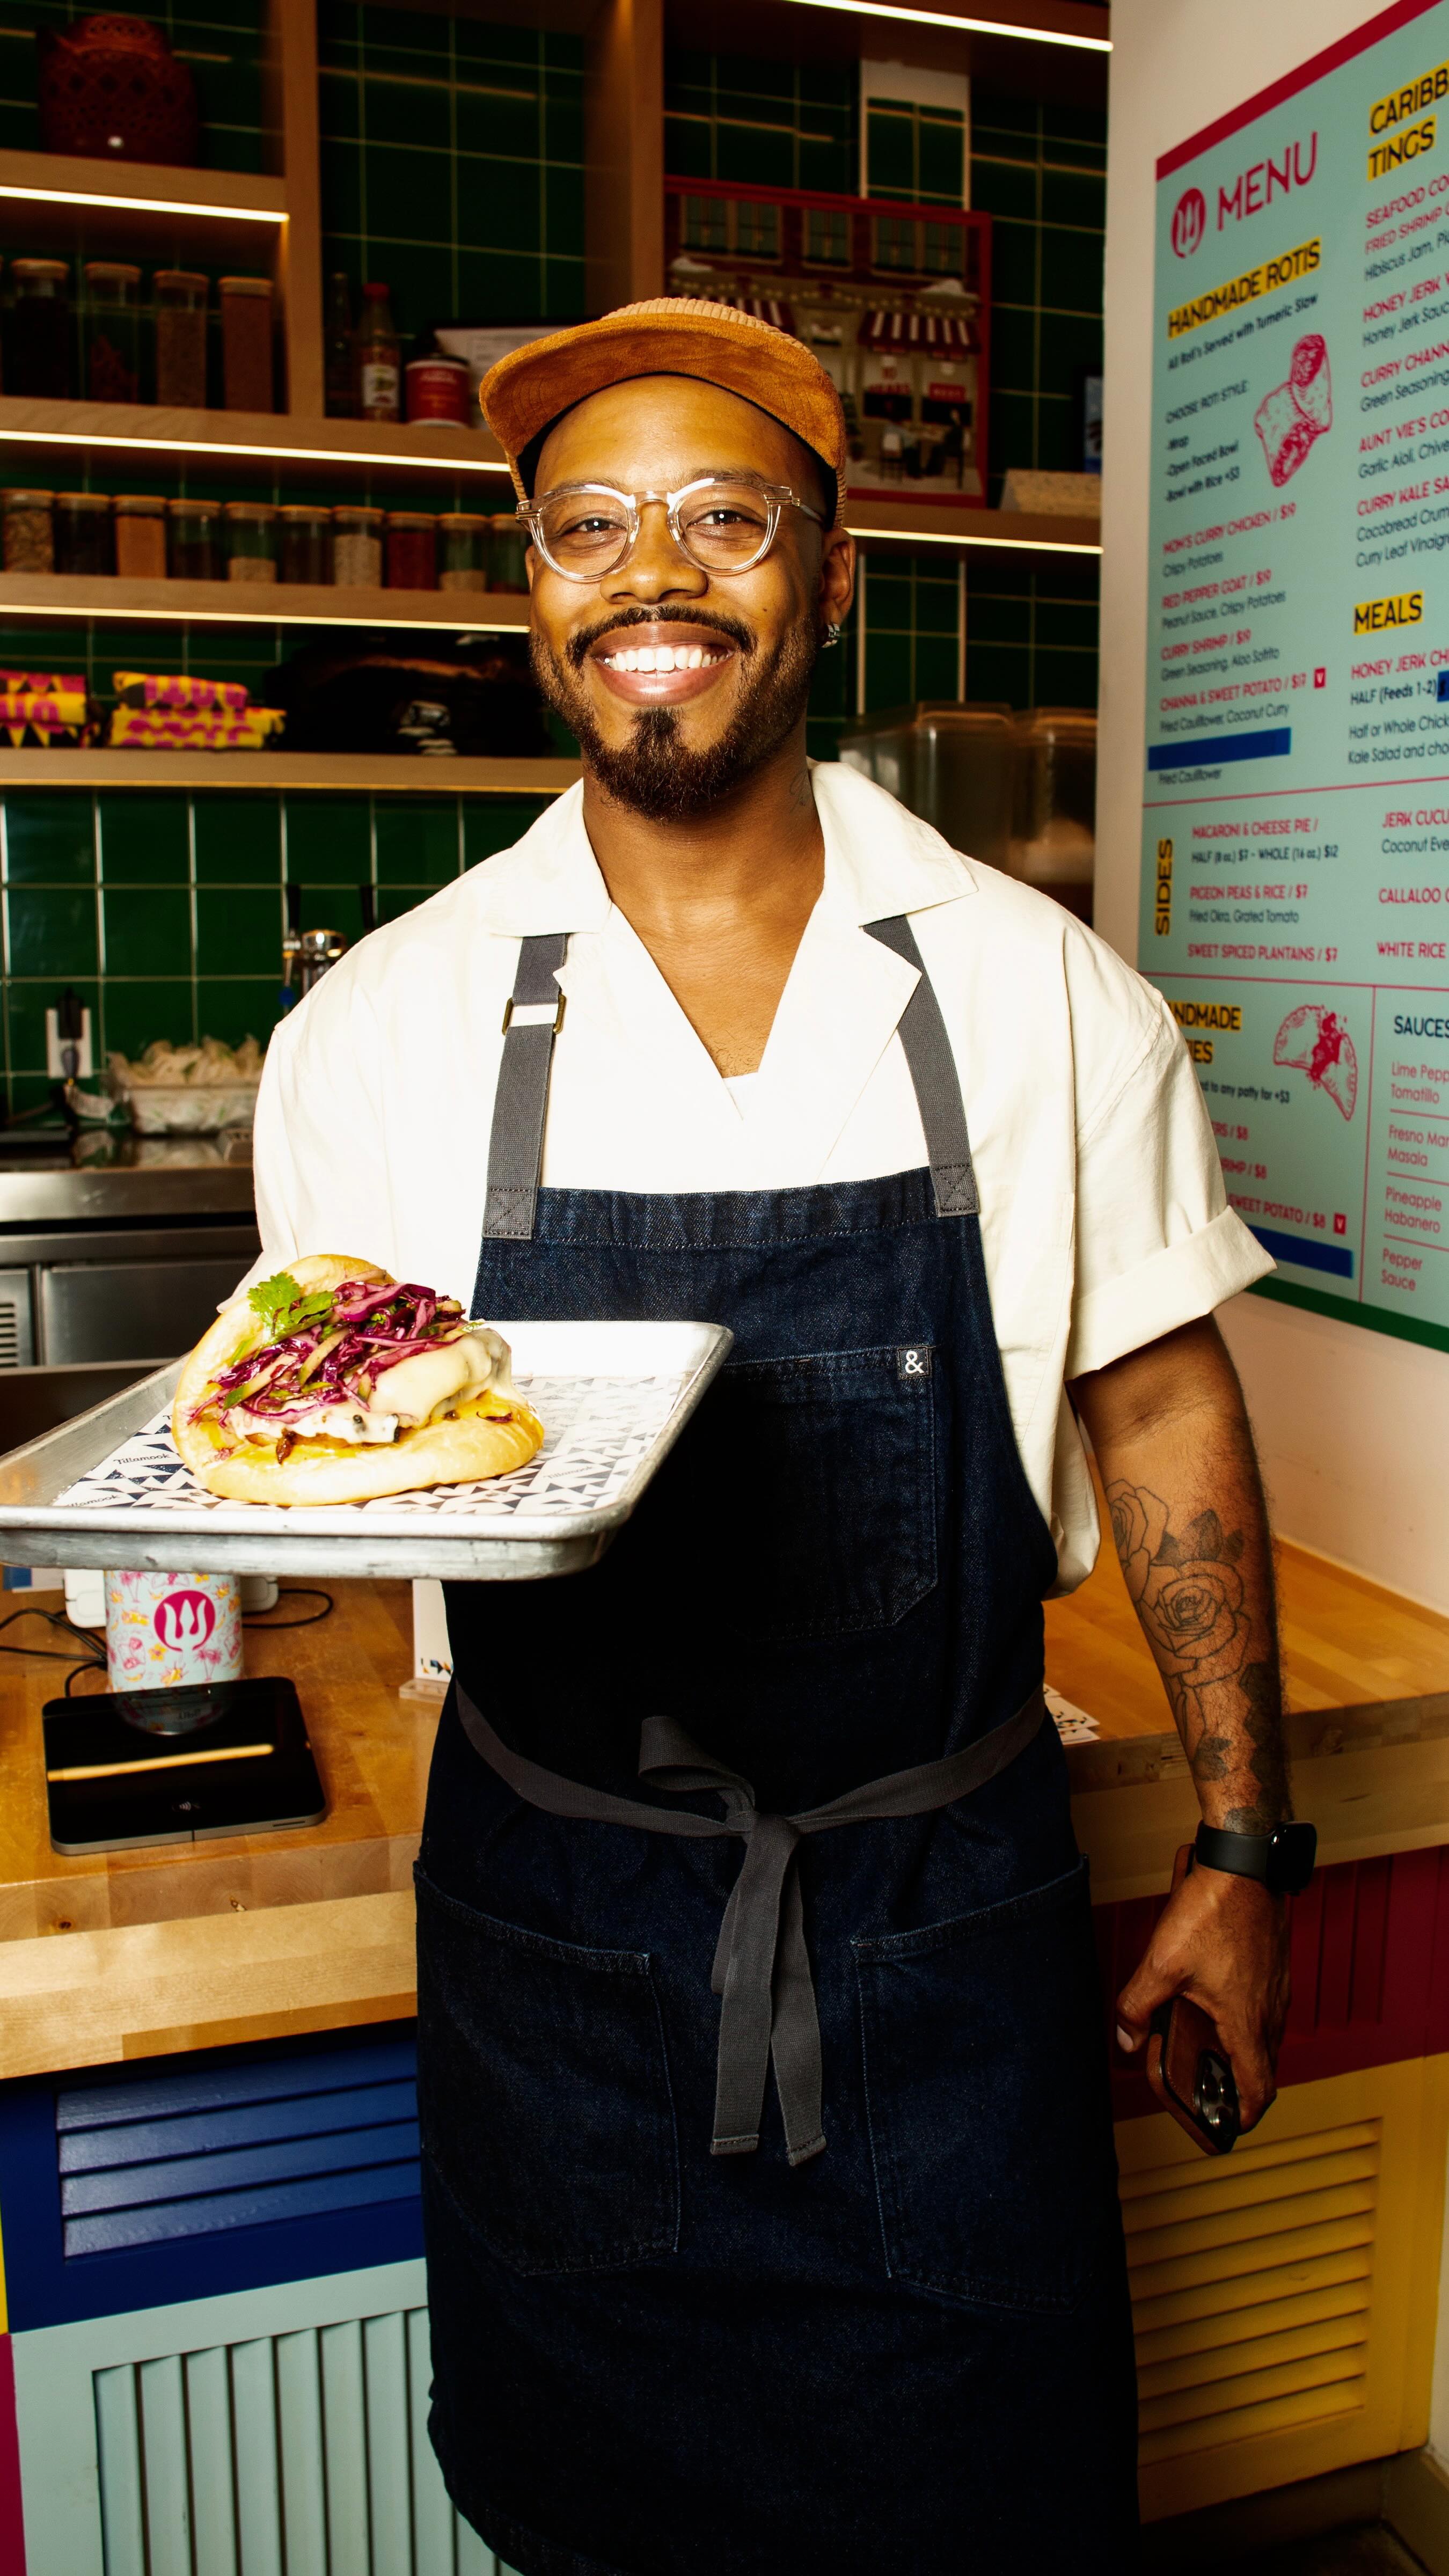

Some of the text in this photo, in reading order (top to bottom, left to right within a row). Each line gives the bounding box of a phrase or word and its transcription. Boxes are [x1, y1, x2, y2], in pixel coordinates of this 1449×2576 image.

[1370, 68, 1448, 134] CARIBB
[1368, 121, 1434, 178] TINGS
[1217, 130, 1318, 232] MENU
[1365, 186, 1426, 229] SEAFOOD
[1365, 229, 1397, 255] FRIED
[1399, 206, 1443, 239] SHRIMP
[1365, 253, 1406, 281] Hibiscus
[1168, 240, 1320, 339] HANDMADE ROTIS
[1363, 290, 1407, 324] HONEY
[1408, 275, 1441, 303] JERK
[1236, 322, 1254, 338] with
[1295, 294, 1319, 312] Slaw
[1363, 324, 1396, 348] Honey
[1399, 312, 1420, 333] Jerk
[1360, 357, 1402, 387] CURRY
[1360, 391, 1393, 412] Green
[1359, 428, 1393, 453] AUNT
[1358, 458, 1389, 479] Garlic
[1356, 491, 1396, 517] CURRY
[1399, 481, 1431, 504] KALE
[1194, 526, 1224, 545] CURRY
[1227, 510, 1271, 536] CHICKEN
[1356, 511, 1417, 542] Cocobread
[1188, 552, 1223, 569] Potatoes
[1356, 539, 1408, 567] Curry Leaf
[1162, 592, 1181, 610] RED
[1182, 582, 1219, 603] PEPPER
[1221, 574, 1247, 595] GOAT
[1219, 602, 1246, 617] Crispy
[1247, 591, 1286, 609] Potatoes
[1354, 594, 1422, 633] MEALS
[1161, 643, 1190, 661] CURRY
[1192, 634, 1228, 654] SHRIMP
[1161, 668, 1185, 682] Green
[1350, 653, 1426, 679] HONEY JERK
[1160, 694, 1197, 713] CHANNA
[1199, 690, 1206, 704] &
[1208, 685, 1240, 704] SWEET
[1242, 678, 1282, 697] POTATO
[1350, 689, 1376, 706] HALF
[1379, 684, 1413, 704] (Feeds
[1416, 678, 1437, 697] 1-2)
[1227, 706, 1264, 723] Coconut
[1266, 702, 1290, 718] Curry
[1349, 723, 1368, 740] Half
[1371, 725, 1380, 737] or
[1383, 718, 1416, 734] Whole
[1349, 750, 1370, 764] Kale
[1372, 745, 1401, 763] Salad
[1403, 742, 1425, 758] and
[1192, 817, 1311, 839] MACARONI & CHEESE PIE
[1382, 810, 1412, 828] JERK
[1258, 846, 1290, 860] WHOLE
[1324, 844, 1338, 858] $12
[1381, 837, 1428, 853] Coconut
[1157, 838, 1173, 935] SIDES
[1190, 883, 1308, 901] PIGEON PEAS & RICE $7
[1378, 887, 1441, 903] CALLALOO
[1233, 909, 1264, 923] Grated
[1267, 909, 1299, 923] Tomato
[1188, 943, 1338, 962] SWEET SPICED PLANTAINS $7
[1376, 941, 1447, 959] WHITE RICE
[1167, 1002, 1241, 1030] NDMADE
[1391, 1062, 1417, 1078] Lime
[1391, 1083, 1440, 1104] Tomatillo
[1388, 1124, 1424, 1144] Fresno
[1388, 1147, 1429, 1167] Masala
[1227, 1194, 1261, 1213] SWEET
[1263, 1201, 1304, 1224] POTATO
[1386, 1185, 1443, 1212] Pineapple
[1385, 1207, 1441, 1233] Habanero
[1382, 1248, 1423, 1270] Pepper
[1381, 1268, 1416, 1291] Sauce
[905, 1350, 925, 1374] &
[113, 1453, 172, 1465] Tillamook
